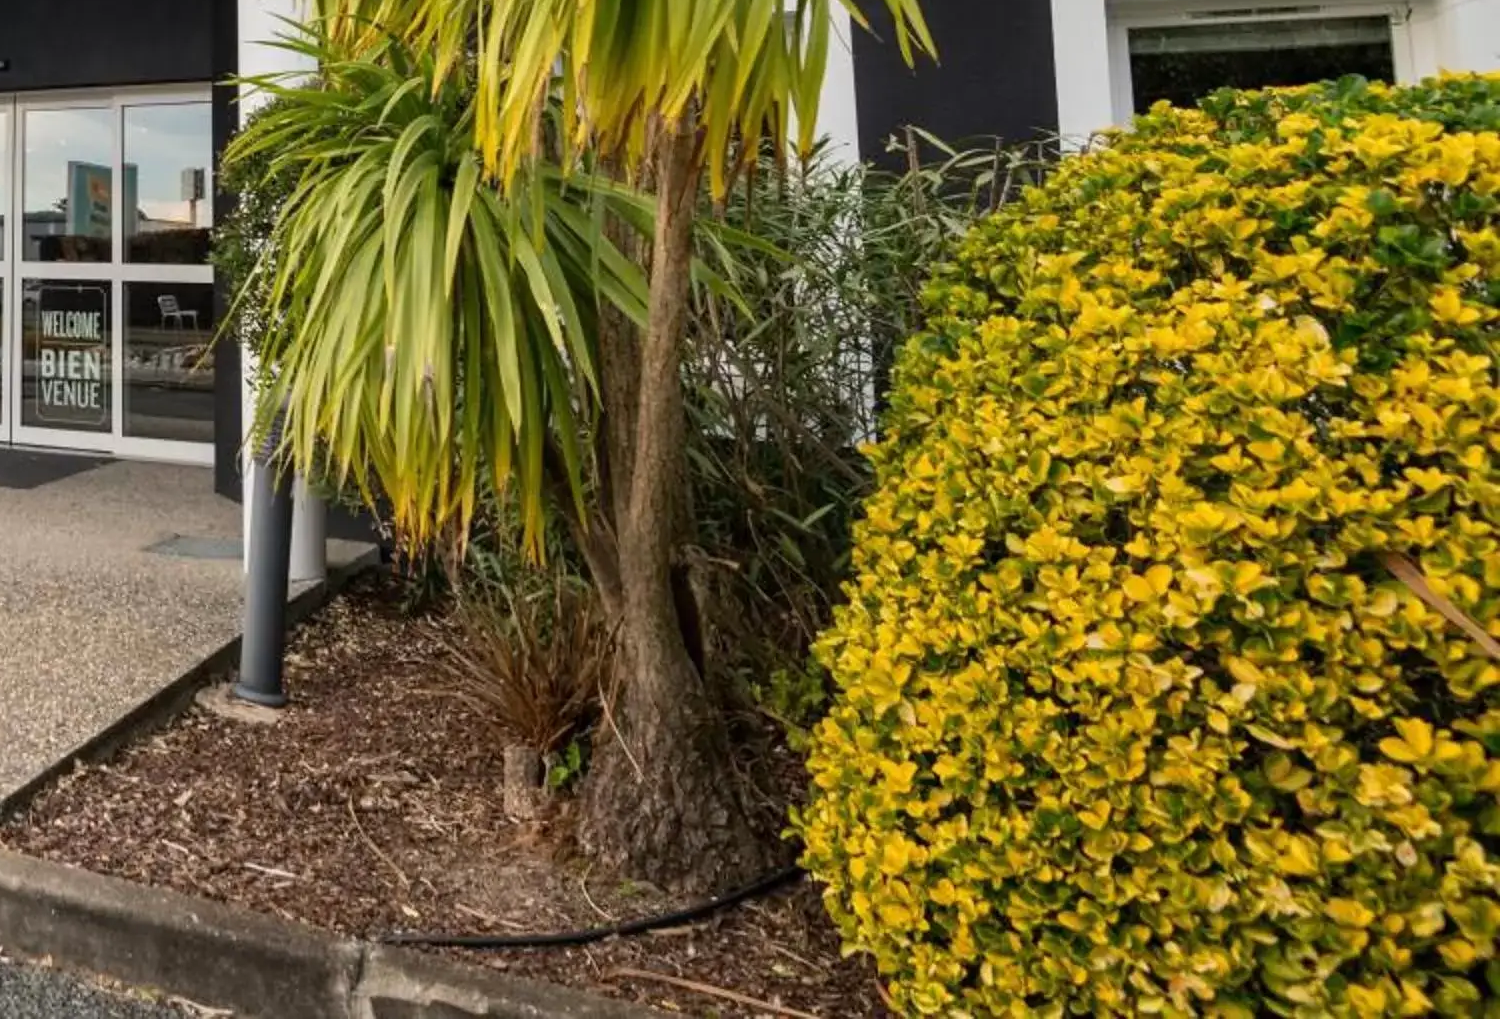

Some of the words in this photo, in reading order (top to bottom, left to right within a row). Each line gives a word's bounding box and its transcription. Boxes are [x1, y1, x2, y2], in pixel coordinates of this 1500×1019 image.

[41, 310, 100, 339] WELCOME
[41, 348, 100, 380] BIEN
[41, 380, 100, 408] VENUE
